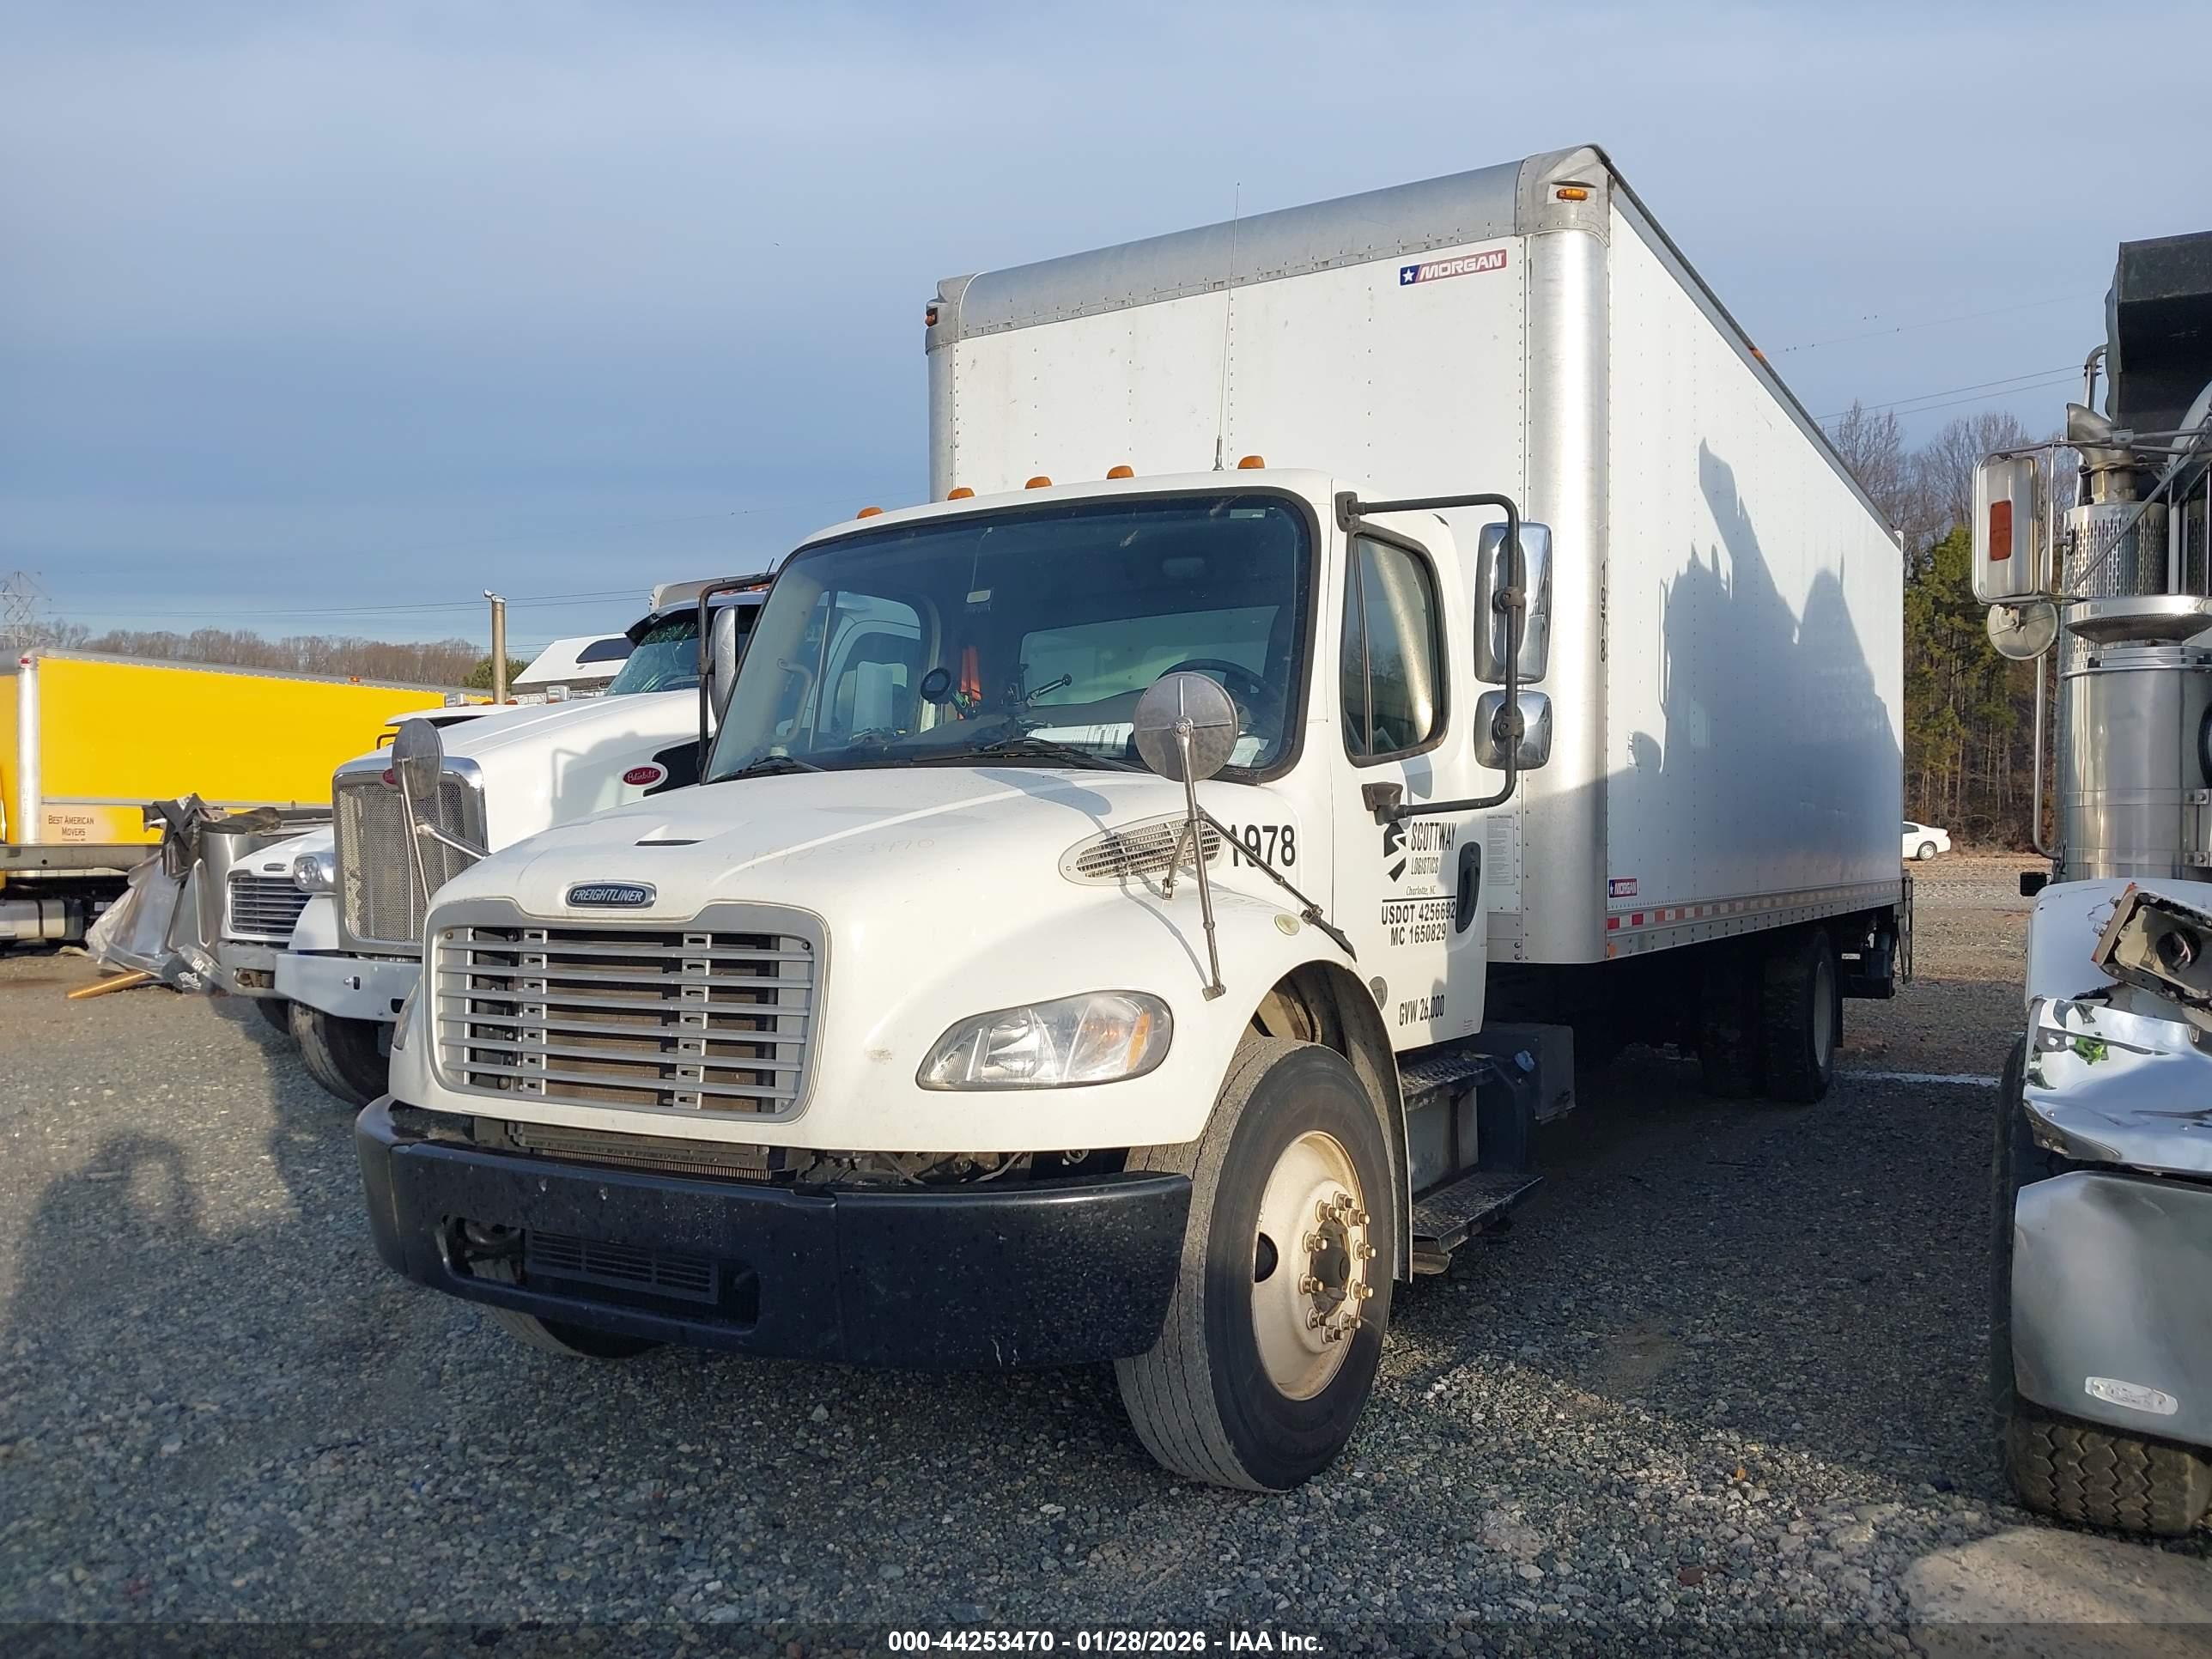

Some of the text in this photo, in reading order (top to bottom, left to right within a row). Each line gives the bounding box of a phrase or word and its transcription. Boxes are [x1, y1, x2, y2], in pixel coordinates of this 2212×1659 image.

[1419, 252, 1505, 282] MORGAN
[61, 827, 86, 836] MOVERS
[64, 815, 94, 825] AMERICAN
[1230, 824, 1296, 867] 1978
[1411, 822, 1457, 852] SCOTTWAY
[1411, 857, 1439, 875] LOGISTICS
[572, 888, 645, 902] FREIGHTLINER
[1406, 884, 1437, 896] Charlotte, NC
[1381, 902, 1456, 925] USDOT 4256692
[1390, 923, 1447, 946] MC 1650829
[1399, 994, 1445, 1026] GVW 26,000
